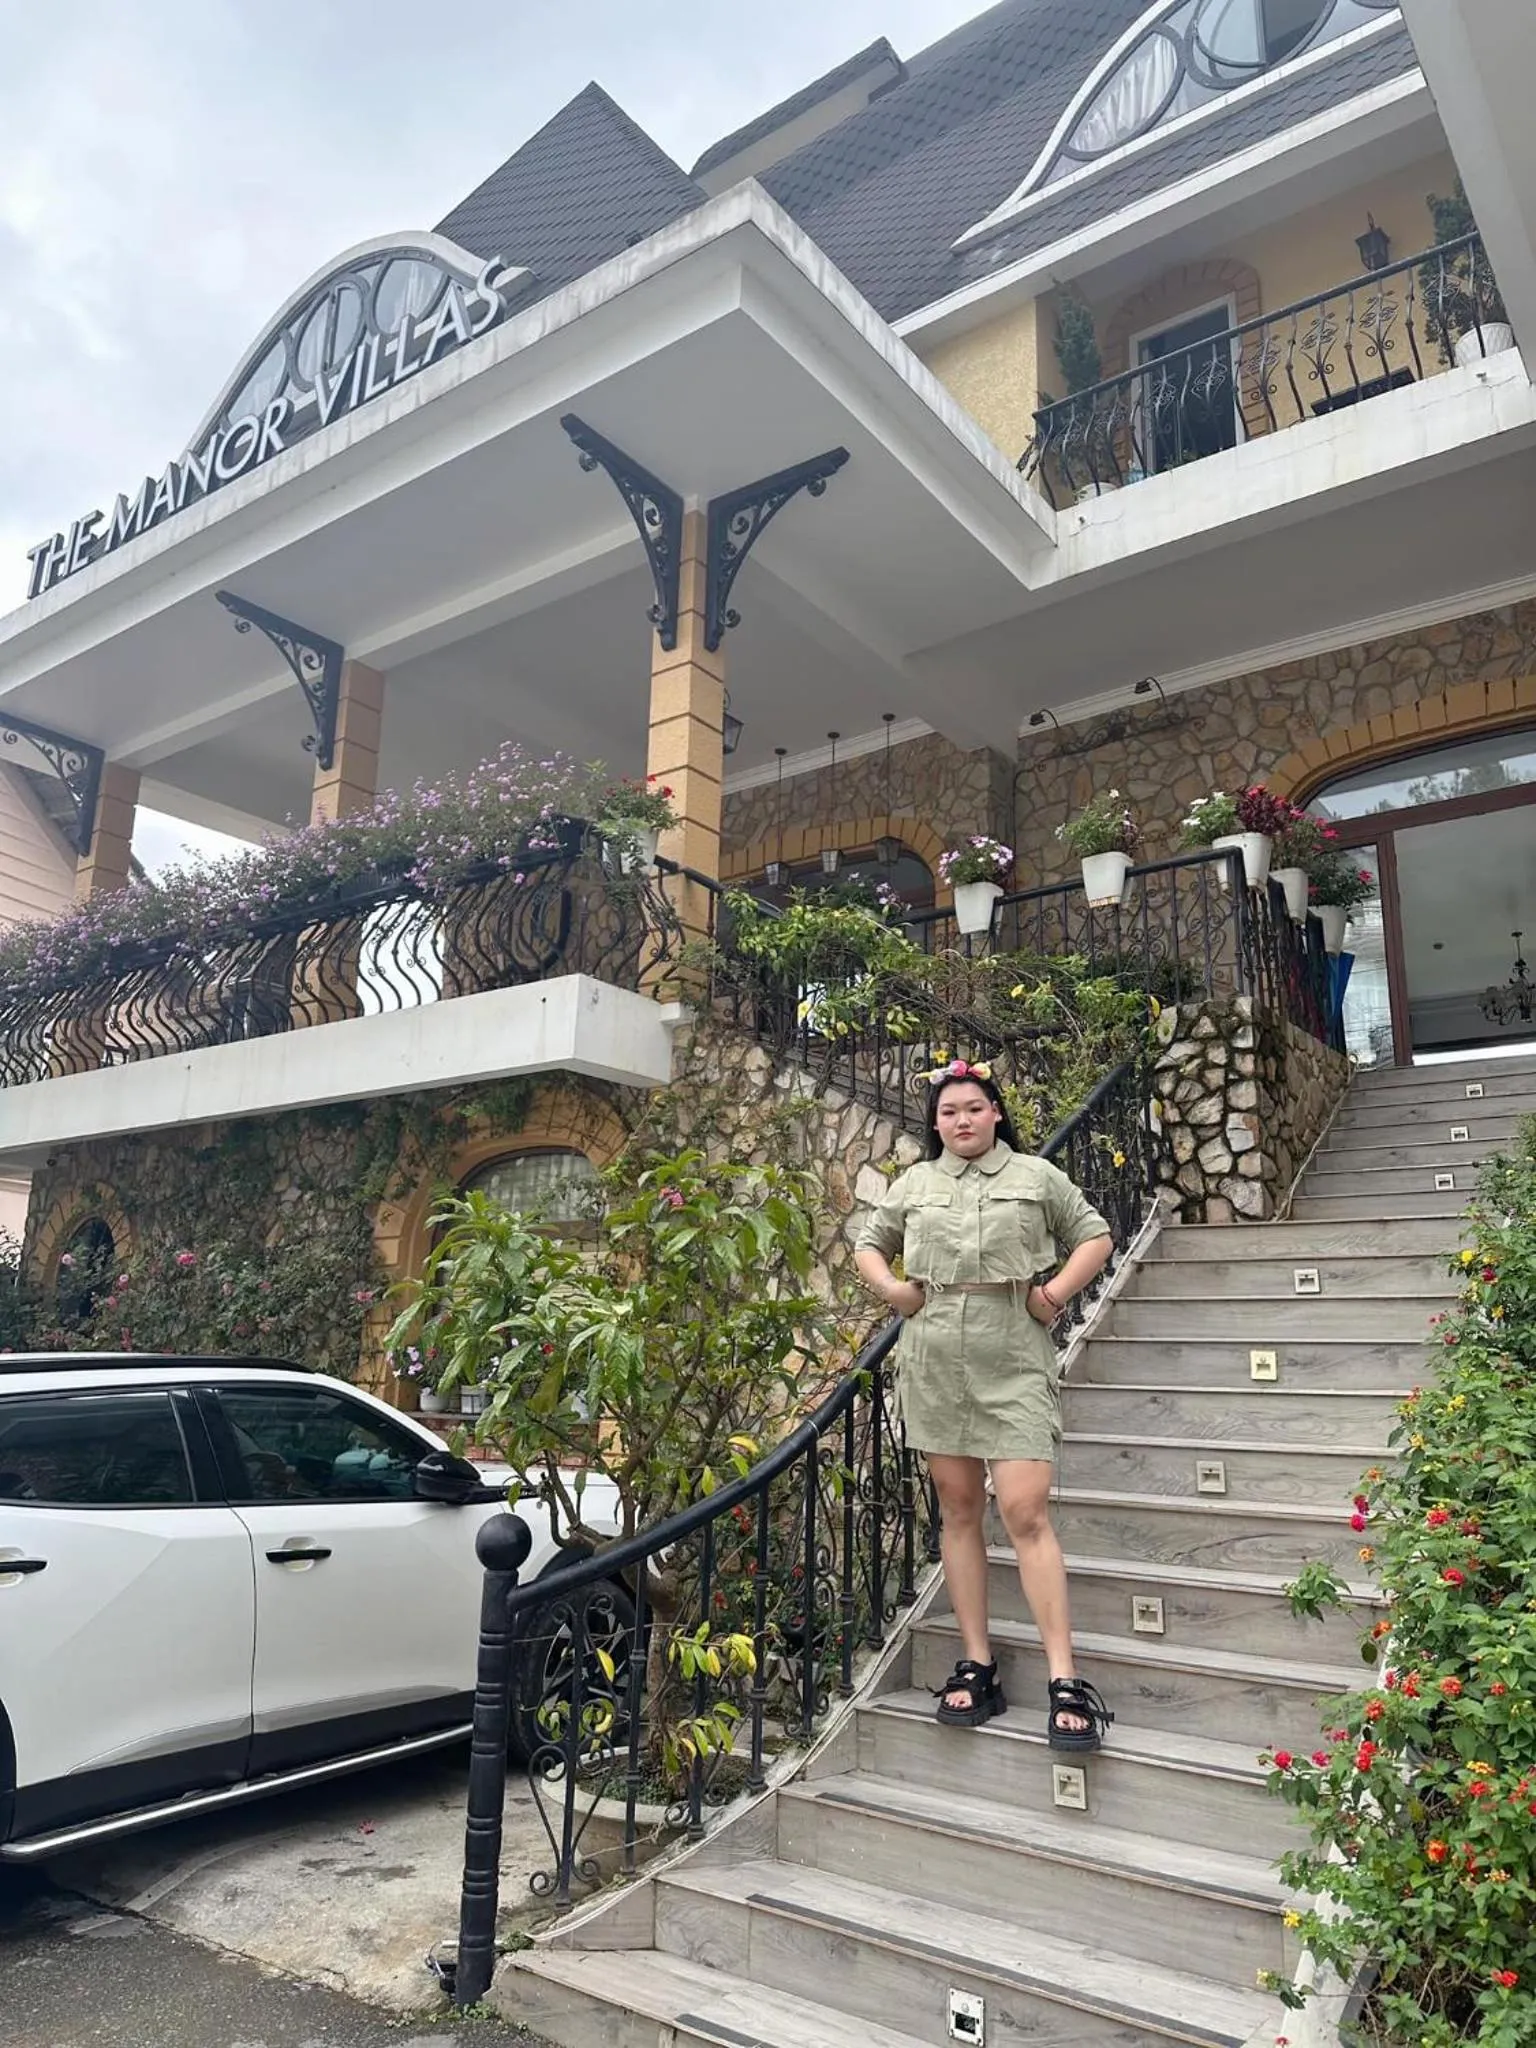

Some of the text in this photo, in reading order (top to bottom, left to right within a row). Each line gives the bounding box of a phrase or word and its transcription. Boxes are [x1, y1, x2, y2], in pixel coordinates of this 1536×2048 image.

[27, 254, 506, 600] THE MANOR VILLAS
